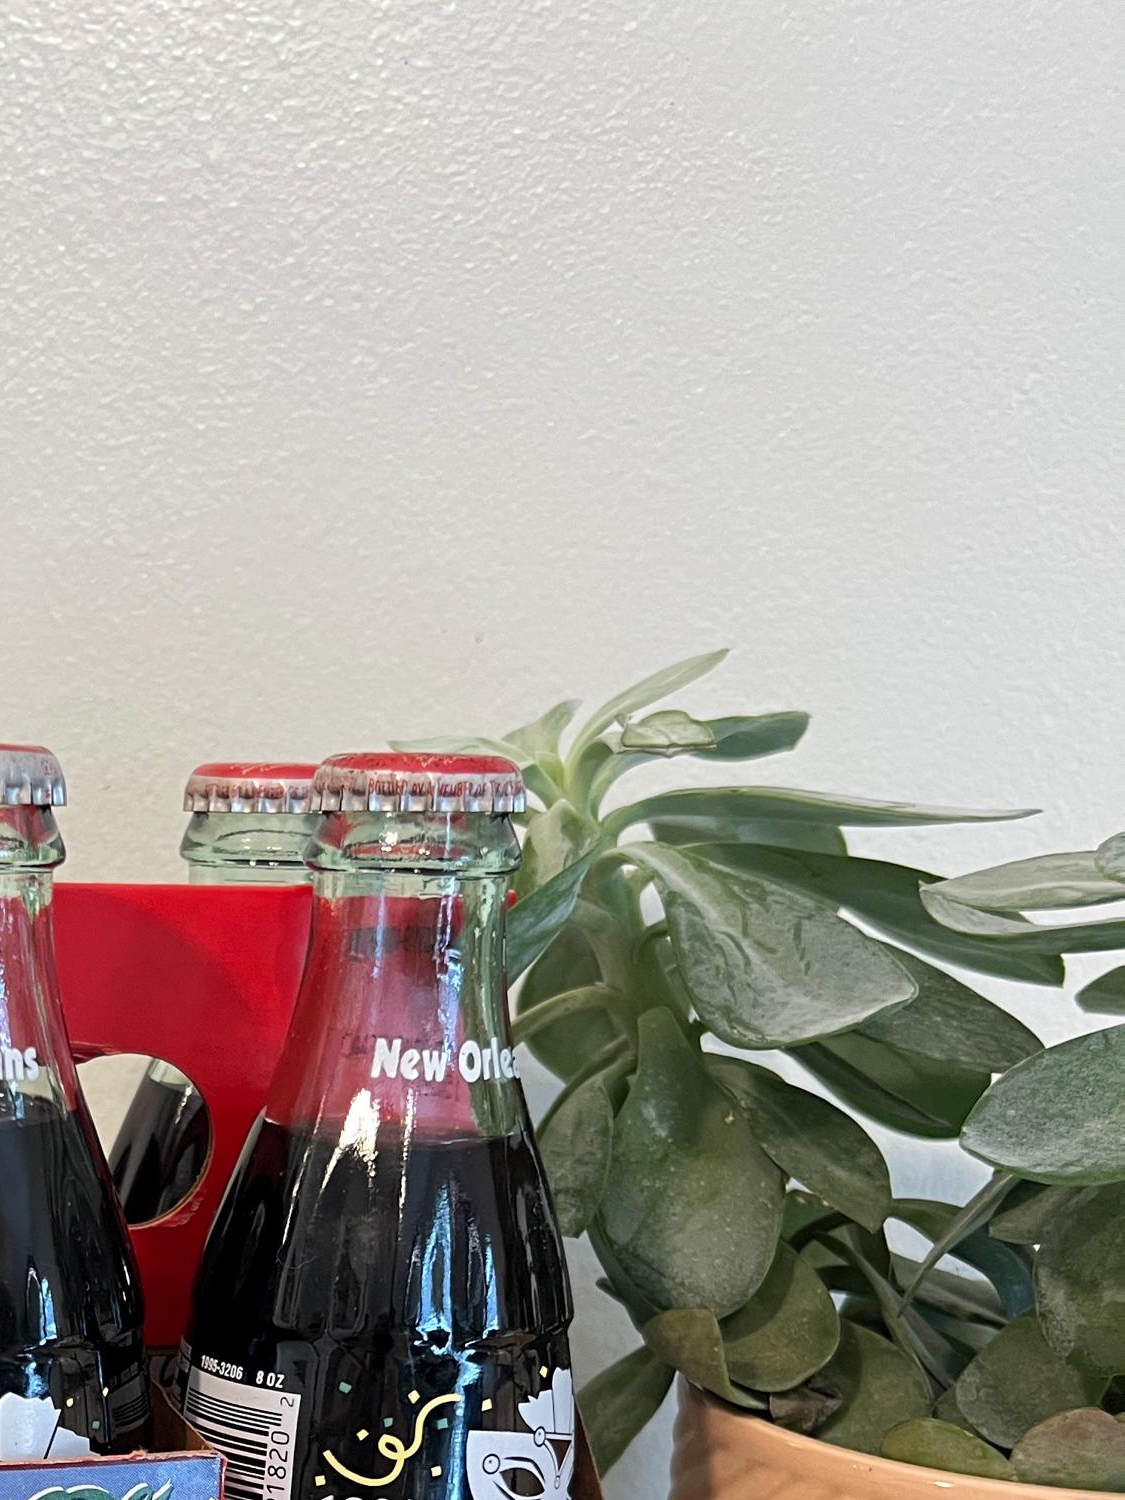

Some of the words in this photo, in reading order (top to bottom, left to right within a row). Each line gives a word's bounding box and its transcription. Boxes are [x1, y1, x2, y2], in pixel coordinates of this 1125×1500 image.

[370, 1038, 447, 1082] New
[458, 1037, 520, 1083] Orlea
[256, 1370, 263, 1385] 8
[267, 1373, 286, 1389] OZ
